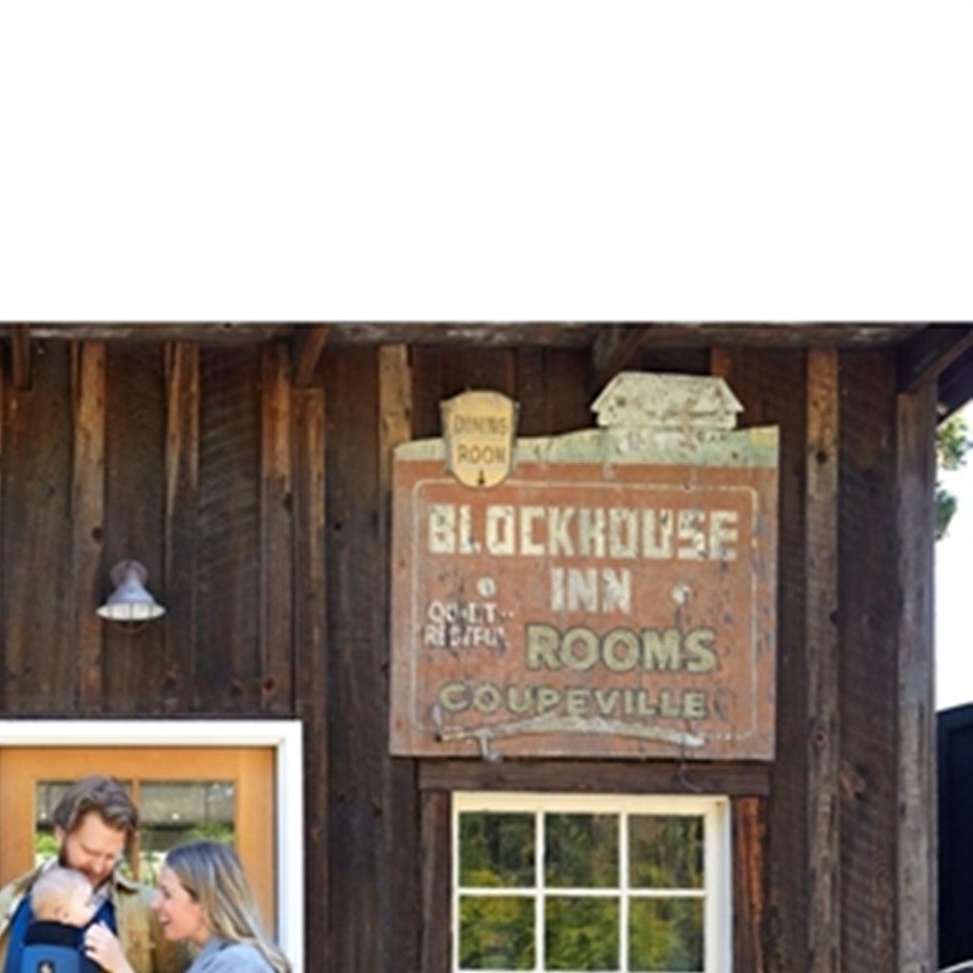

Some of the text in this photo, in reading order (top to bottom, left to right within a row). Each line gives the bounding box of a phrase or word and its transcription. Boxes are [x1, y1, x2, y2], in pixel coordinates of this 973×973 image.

[454, 414, 507, 436] DINING
[457, 443, 507, 465] ROOM
[428, 504, 739, 561] BLOCKHOUSE
[551, 567, 633, 613] INN
[526, 623, 718, 673] ROOMS
[438, 682, 709, 719] COUPEVILLE
